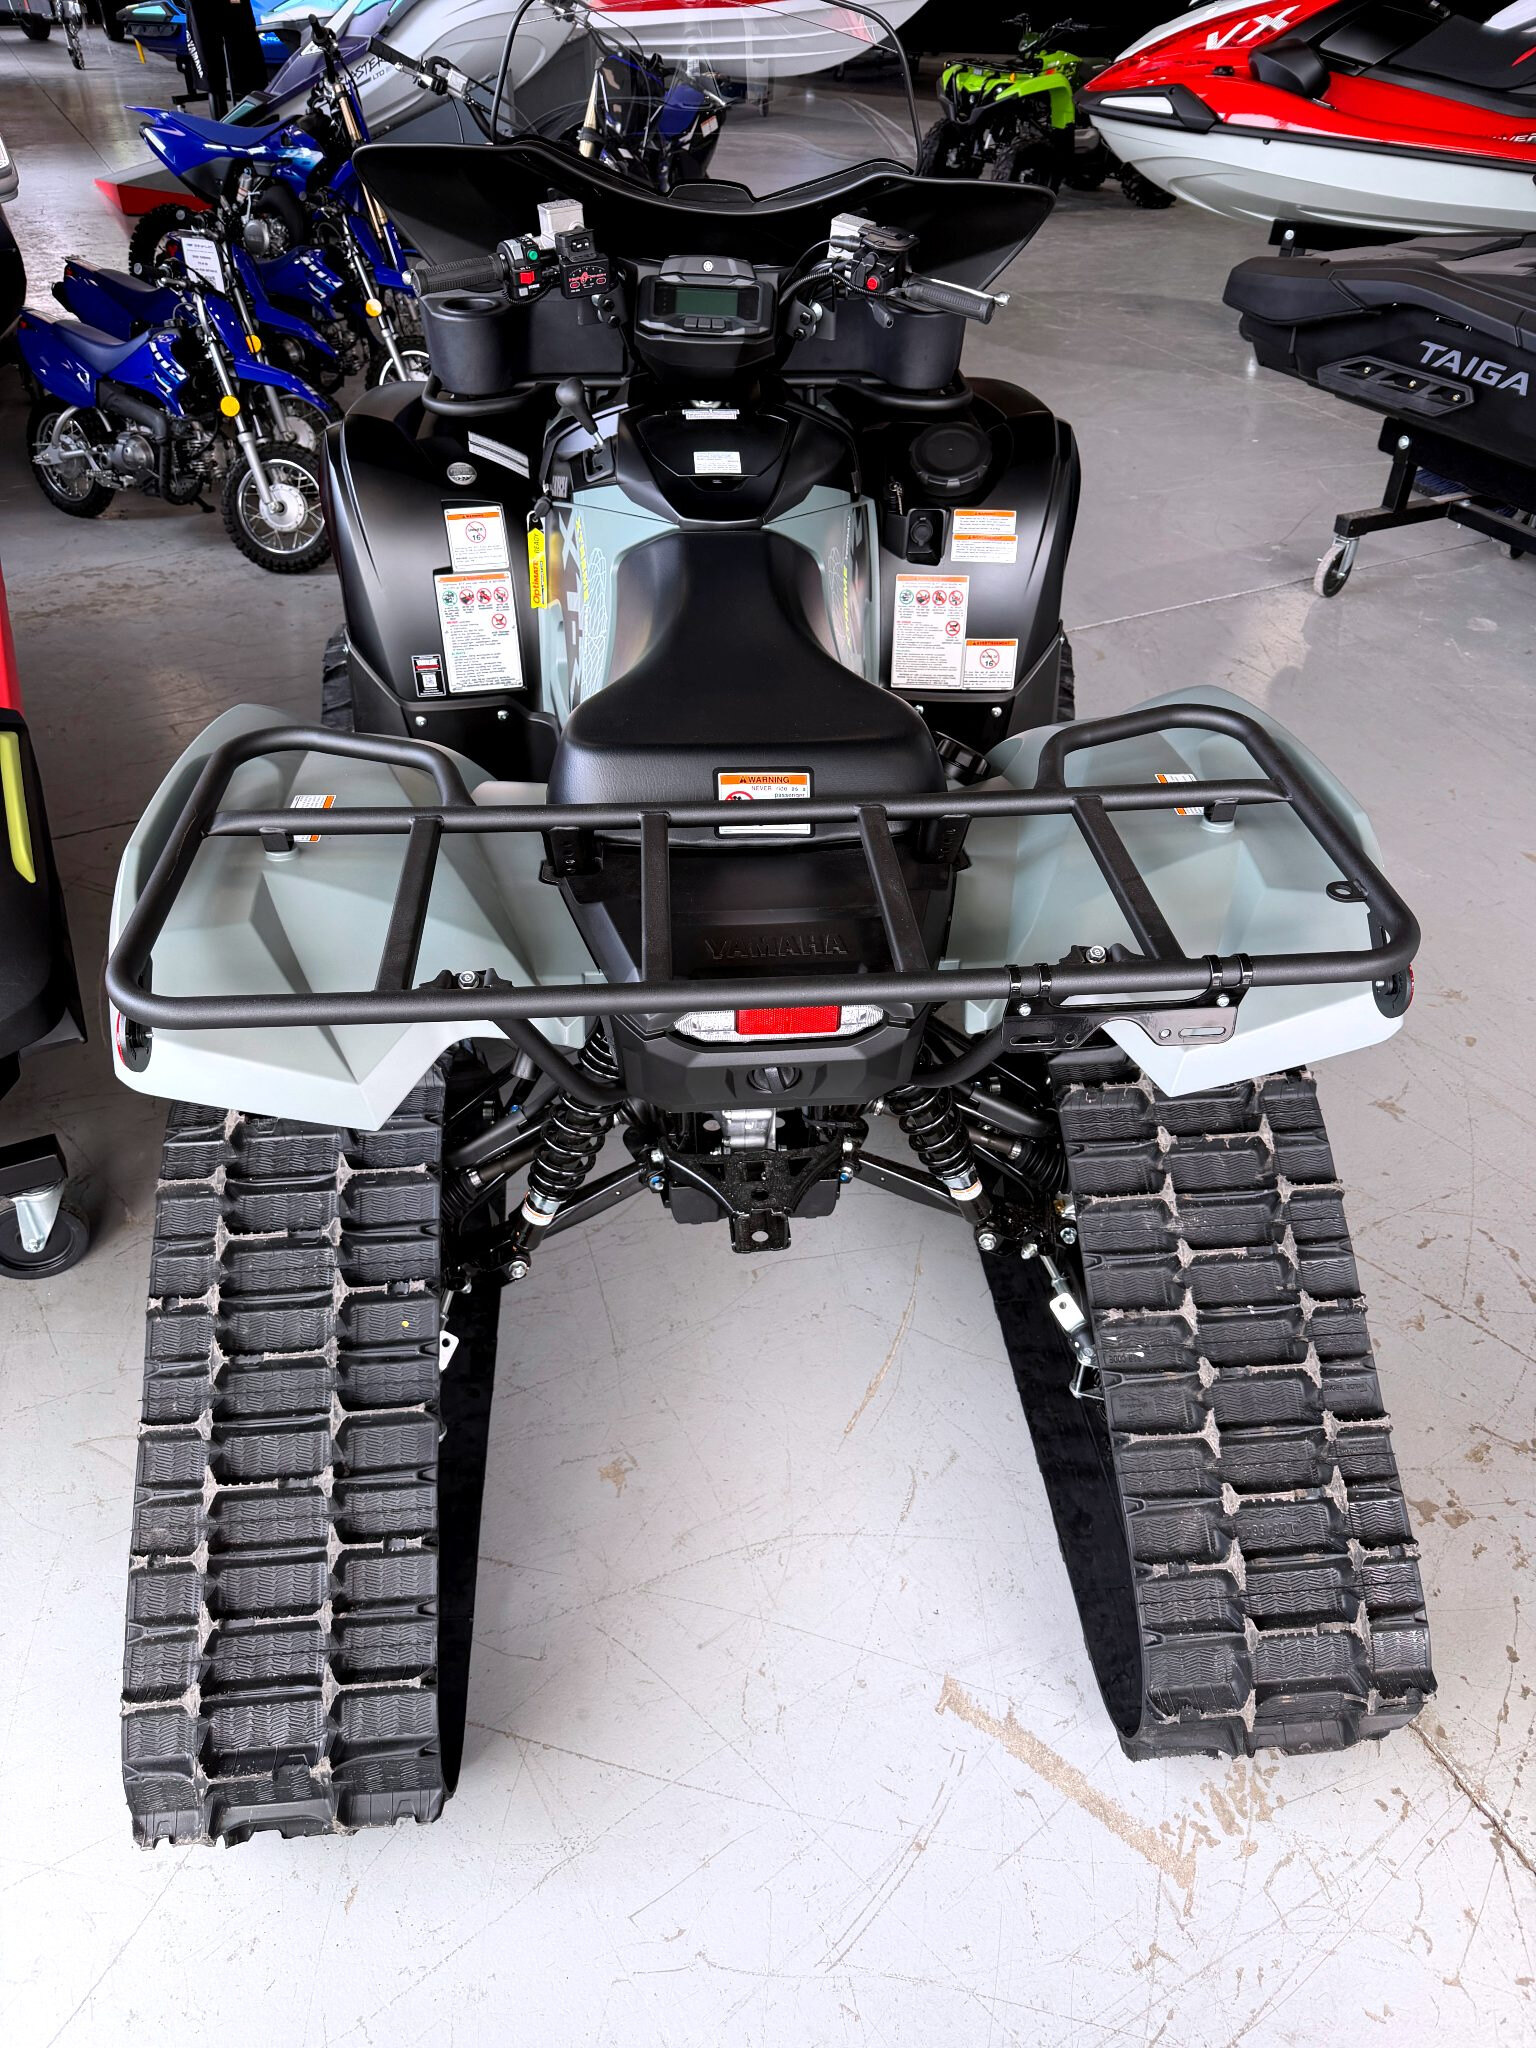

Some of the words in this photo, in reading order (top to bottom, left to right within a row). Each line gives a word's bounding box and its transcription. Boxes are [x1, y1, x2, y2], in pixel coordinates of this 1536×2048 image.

[1205, 4, 1301, 50] VX
[187, 40, 204, 79] YAMAHA
[372, 69, 385, 81] LTD
[1420, 340, 1530, 396] TAIGA
[748, 776, 790, 784] WARNING
[704, 935, 848, 959] YAMAHA
